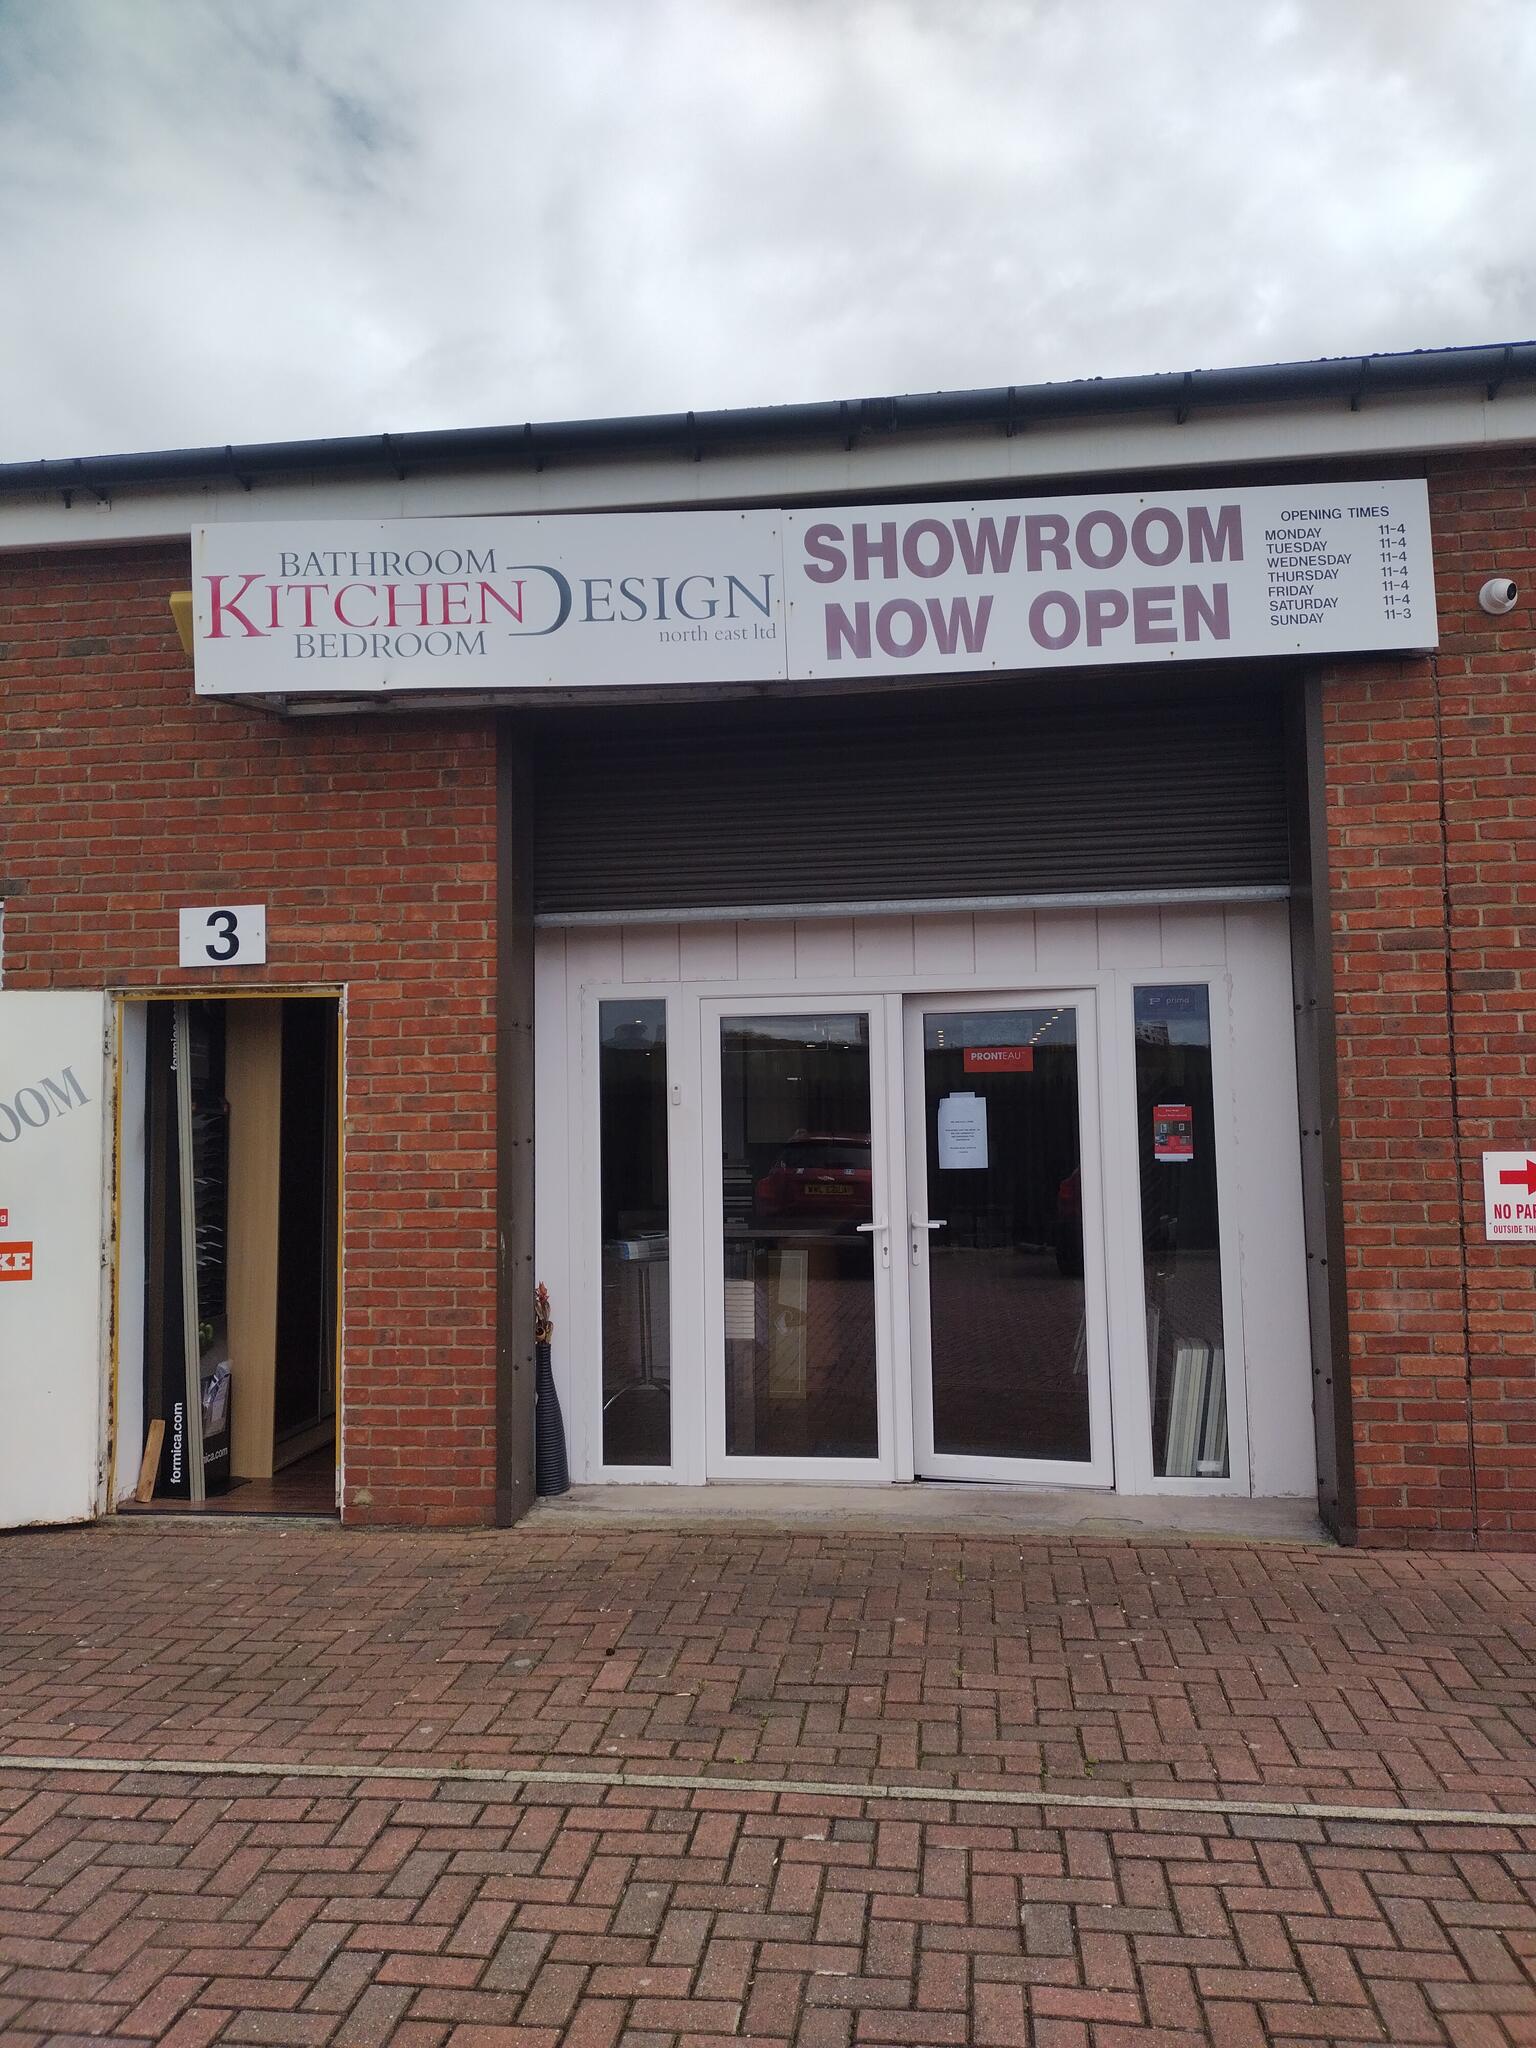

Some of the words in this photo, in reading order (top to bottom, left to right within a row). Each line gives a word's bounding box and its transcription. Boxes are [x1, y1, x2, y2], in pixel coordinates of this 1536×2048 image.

[1281, 509, 1342, 521] OPENING
[1347, 506, 1389, 518] TIMES
[1265, 528, 1321, 540] MONDAY
[1379, 524, 1406, 535] 11-4
[803, 505, 1244, 584] SHOWROOM
[1266, 541, 1327, 554] TUESDAY
[1380, 537, 1407, 549] 11-4
[279, 548, 496, 578] BATHROOM
[1267, 554, 1352, 568] WEDNESDAY
[1380, 551, 1407, 563] 11-4
[1268, 569, 1339, 582] THURSDAY
[1381, 566, 1408, 577] 11-4
[1268, 585, 1314, 597] FRIDAY
[1382, 580, 1409, 591] 11-4
[202, 574, 527, 639] KITCHEN
[1270, 598, 1338, 611] SATURDAY
[1383, 594, 1410, 605] 11-4
[824, 595, 994, 660] NOW
[1028, 583, 1230, 650] OPEN
[1270, 613, 1324, 626] SUNDAY
[1384, 608, 1412, 619] 11-3
[658, 625, 709, 642] north
[713, 625, 749, 641] east
[753, 623, 777, 640] ltd
[294, 630, 488, 659] BEDROOM
[206, 910, 239, 961] 3
[970, 1051, 1021, 1061] PRONTEAU
[1494, 1204, 1511, 1219] NO
[1494, 1225, 1522, 1233] OUTSIDE
[170, 1402, 182, 1484] formica.com
